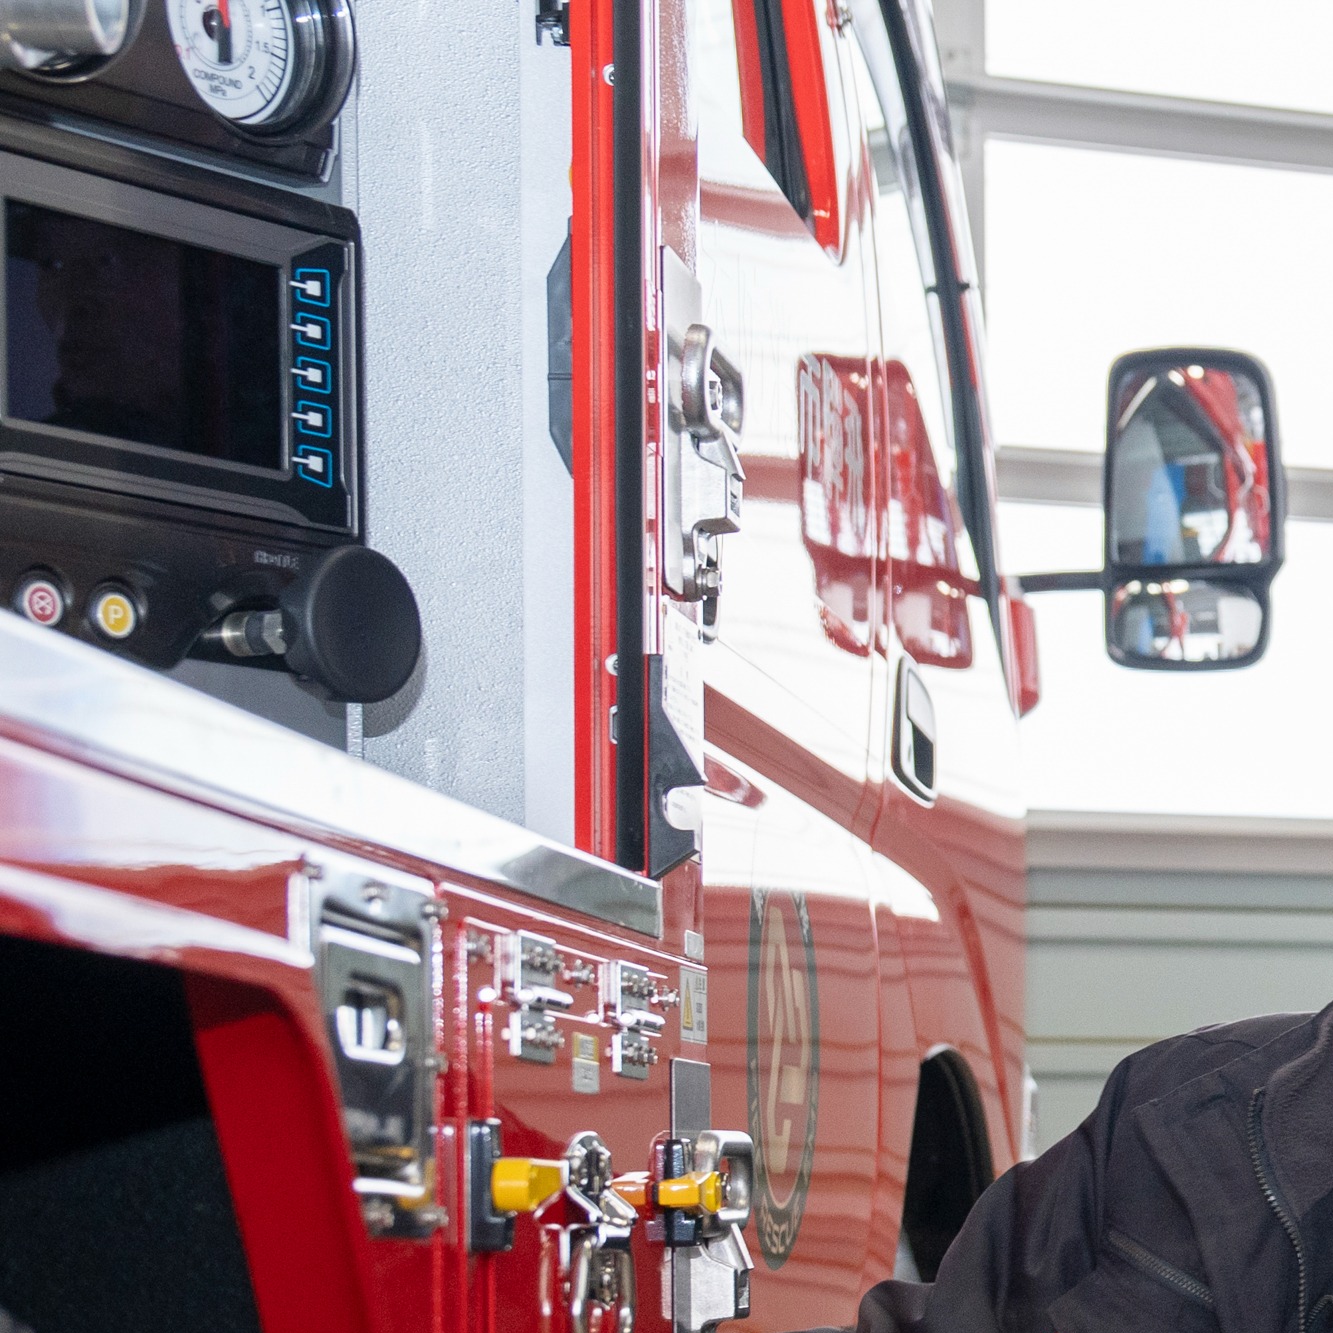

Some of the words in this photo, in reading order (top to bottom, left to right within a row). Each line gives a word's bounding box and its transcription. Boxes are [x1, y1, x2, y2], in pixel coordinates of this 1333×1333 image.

[193, 67, 243, 90] COMPOUND
[248, 66, 256, 80] 2
[209, 83, 228, 97] MPa
[108, 604, 124, 625] P
